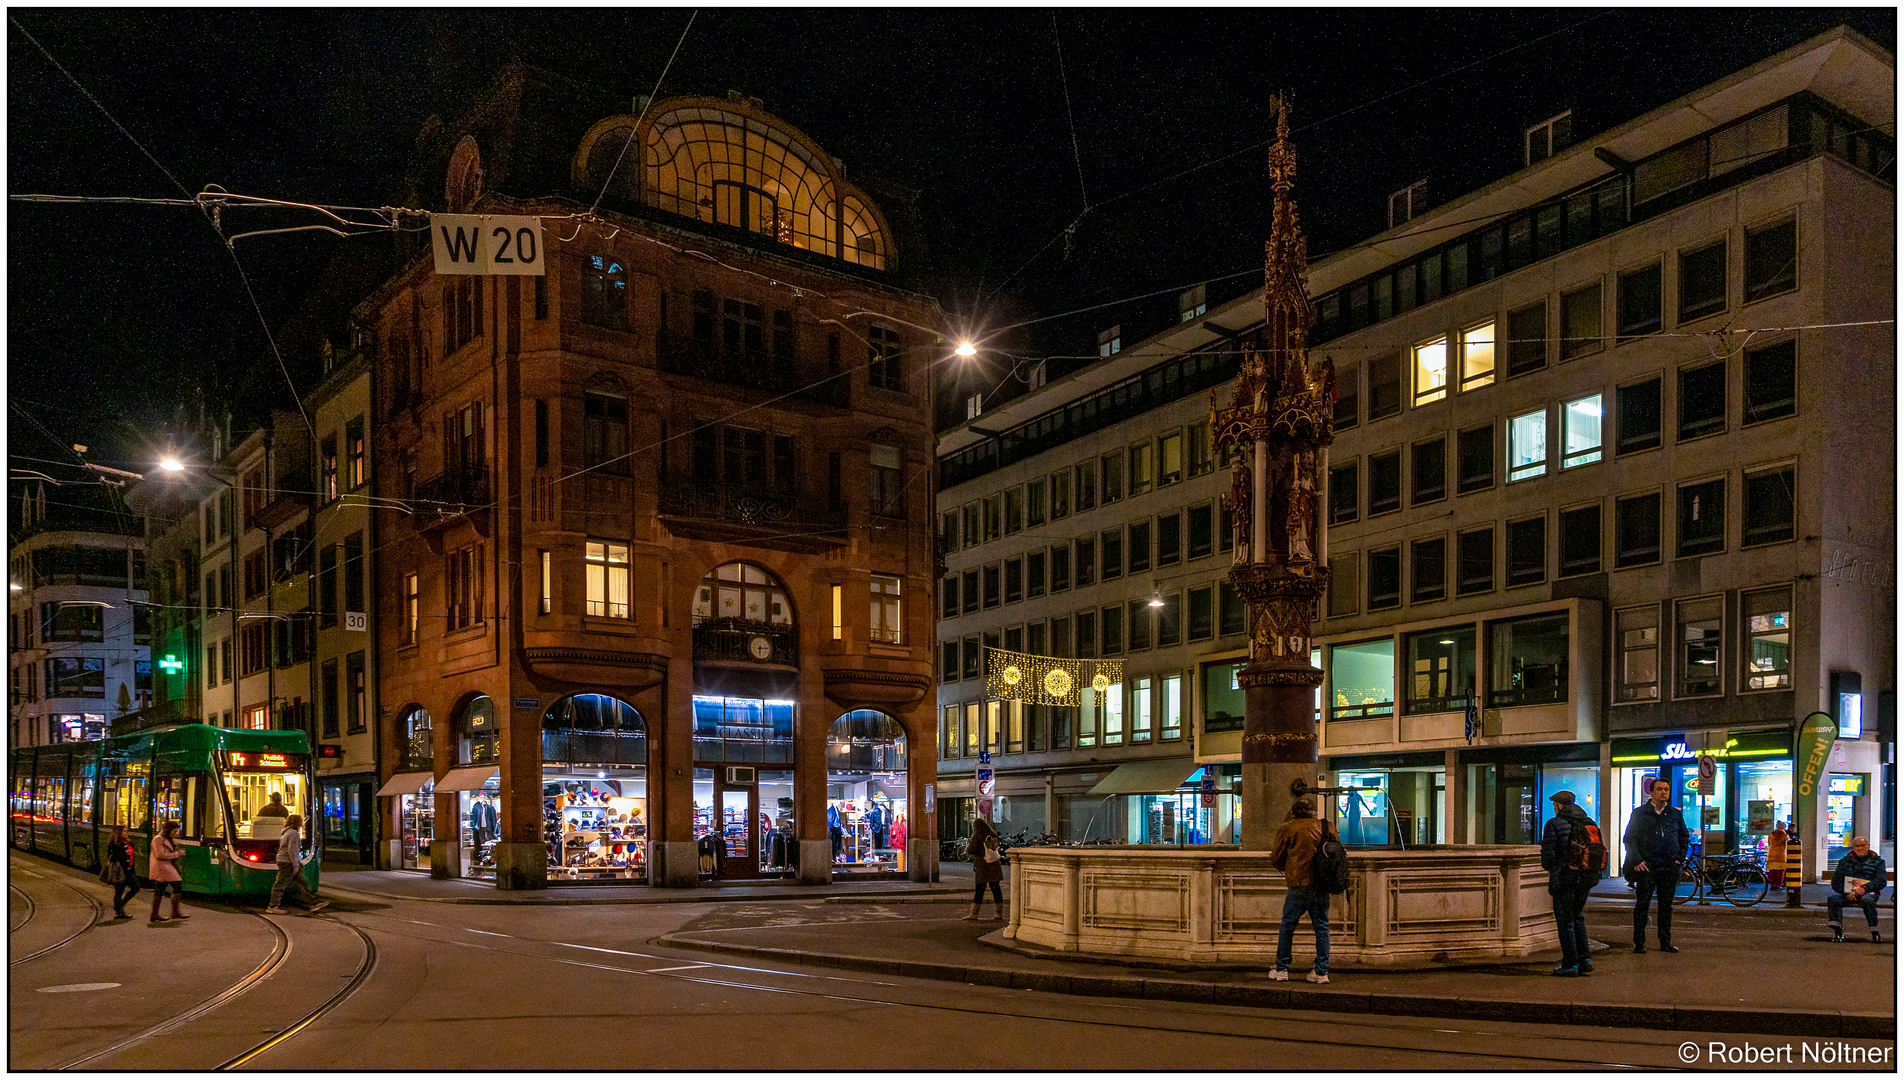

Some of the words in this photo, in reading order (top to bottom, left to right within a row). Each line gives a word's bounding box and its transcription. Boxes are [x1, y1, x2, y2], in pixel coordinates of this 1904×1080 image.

[441, 226, 479, 263] W
[493, 227, 536, 264] 20
[348, 615, 364, 628] 30
[719, 727, 770, 739] CLASSIC
[1799, 737, 1828, 795] OFFEN!
[1829, 779, 1862, 792] SUBWAY
